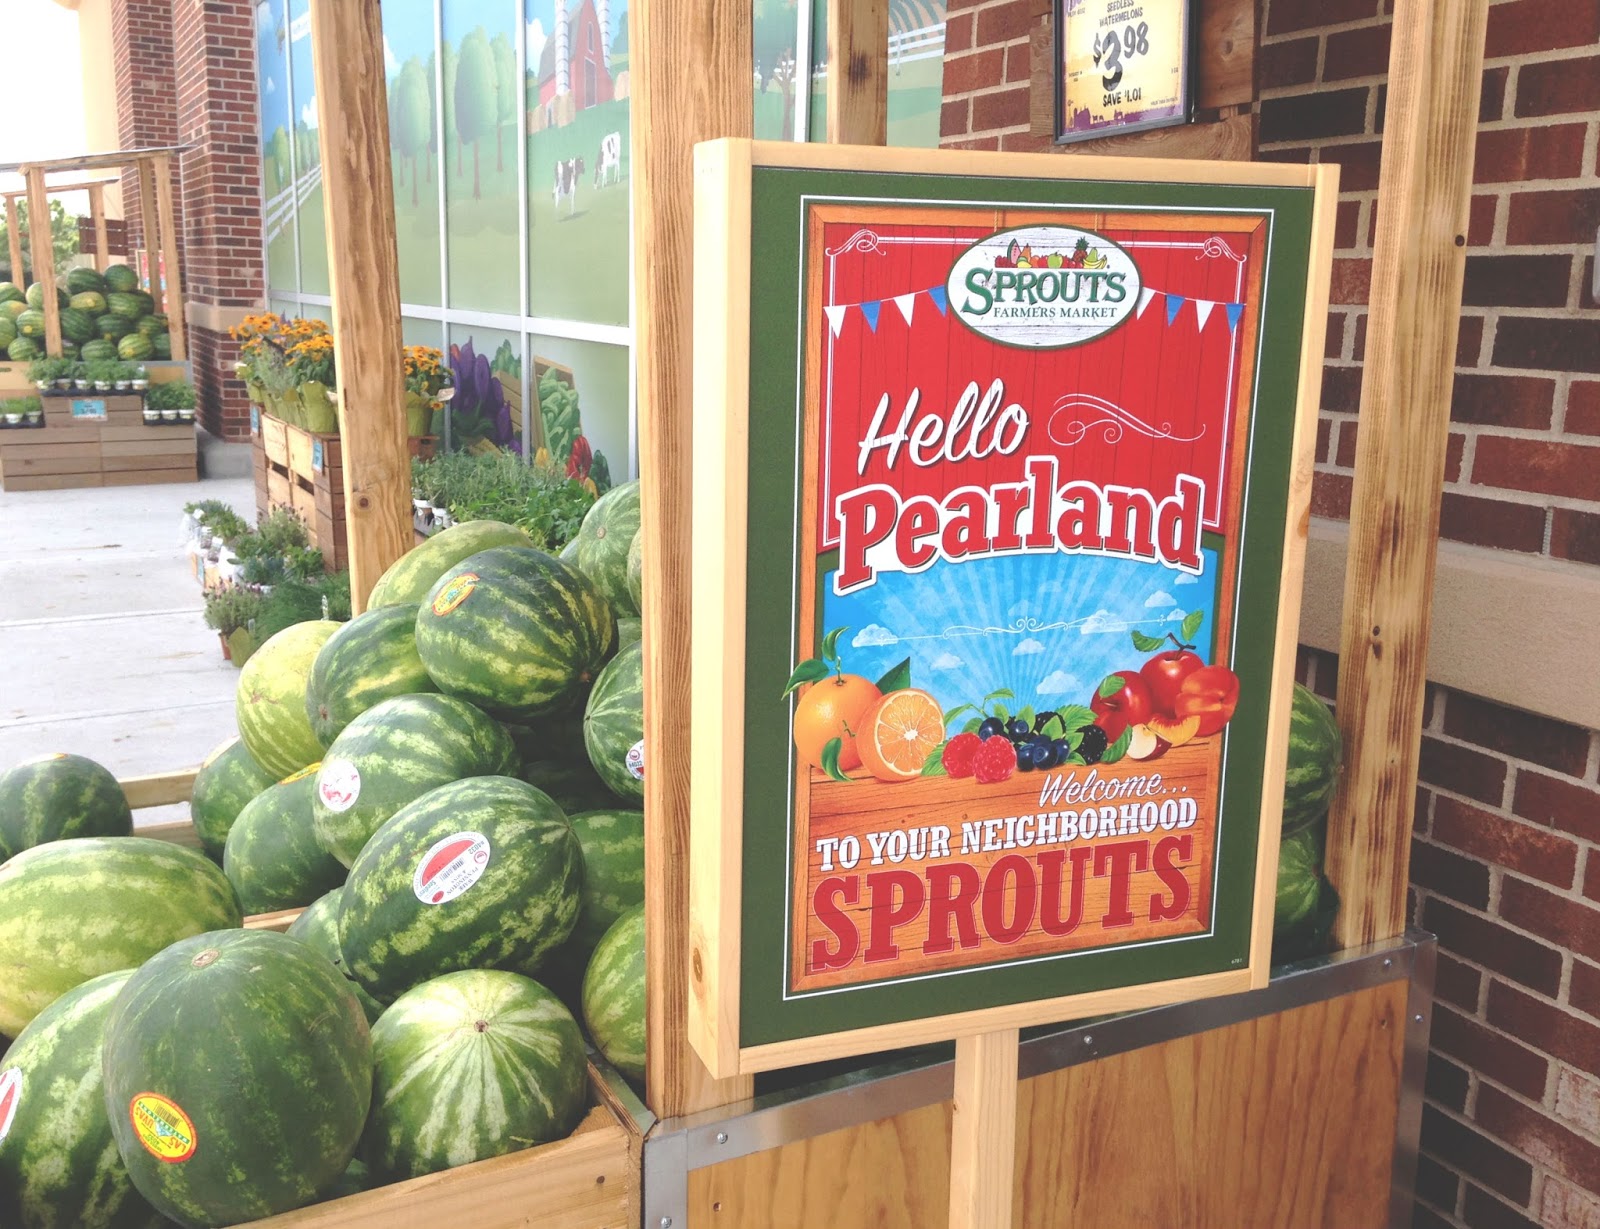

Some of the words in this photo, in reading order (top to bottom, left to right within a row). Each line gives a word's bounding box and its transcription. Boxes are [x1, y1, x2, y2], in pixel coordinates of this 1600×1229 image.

[1099, 7, 1143, 28] WATERMELONS
[1103, 92, 1121, 107] SAVE
[960, 267, 1127, 315] SPROUTS
[993, 306, 1056, 318] FARMERS
[1059, 306, 1118, 318] MARKET
[857, 377, 1029, 476] Hello
[836, 457, 1203, 593] Pearland
[816, 834, 861, 872] TO
[866, 824, 952, 866] YOUR
[960, 796, 1199, 856] NEIGHBORHOOD
[810, 833, 1195, 973] SPROUTS
[135, 1106, 154, 1129] UVAS
[168, 1136, 187, 1153] LAS
